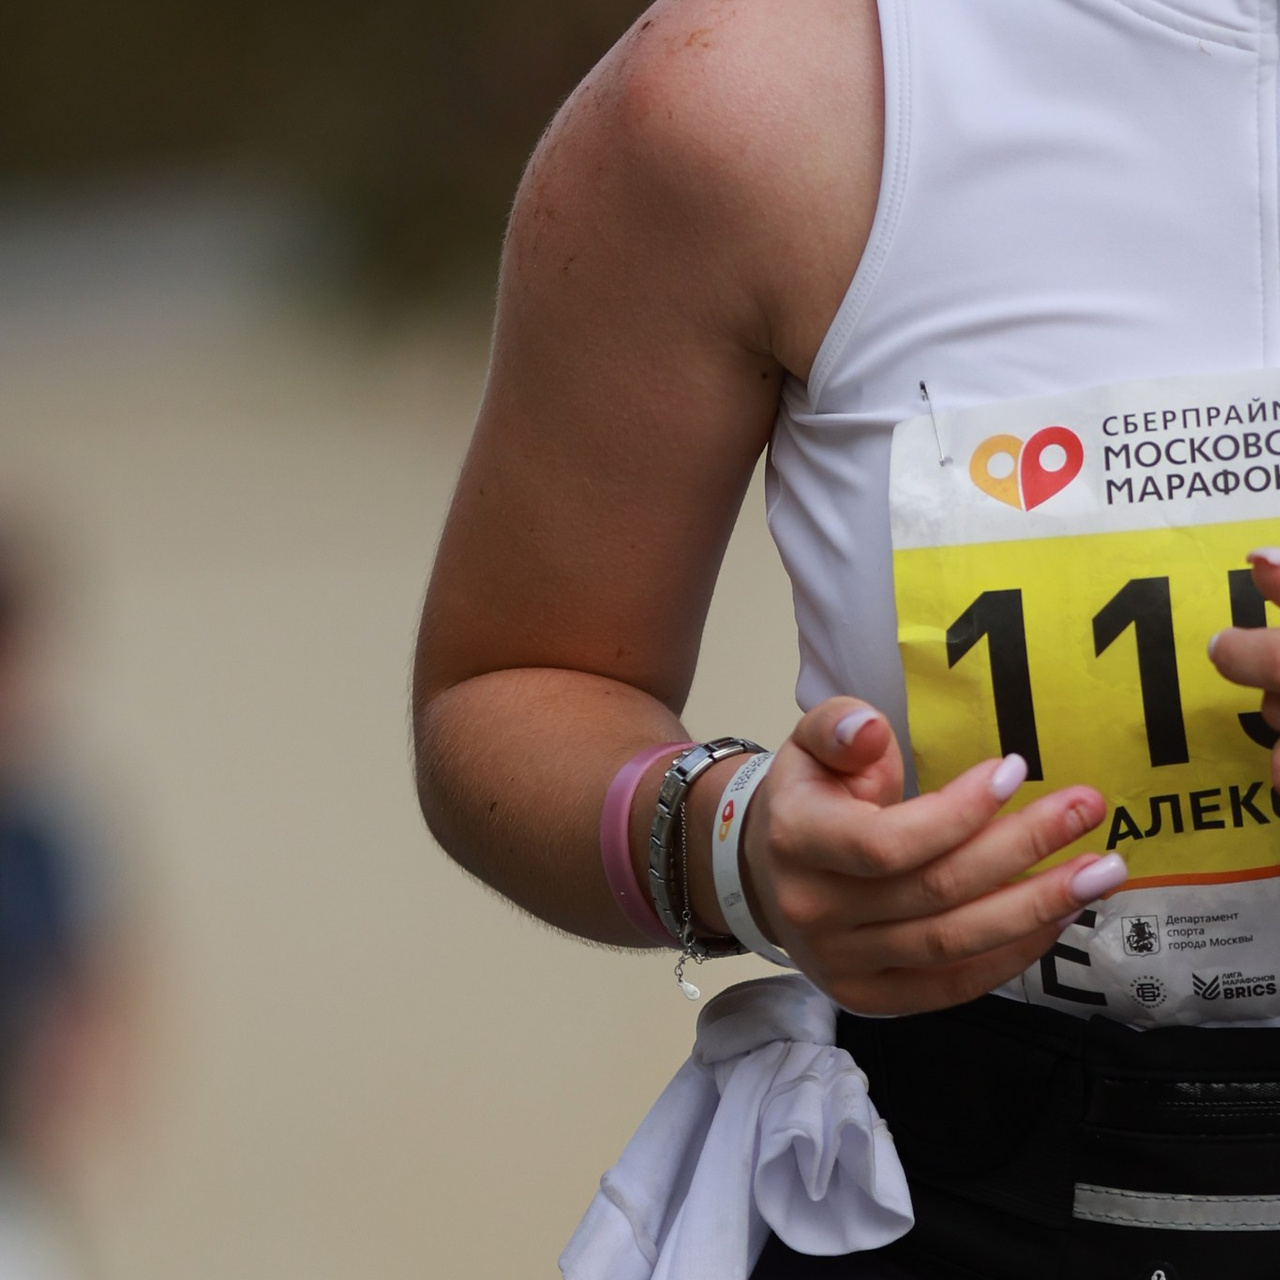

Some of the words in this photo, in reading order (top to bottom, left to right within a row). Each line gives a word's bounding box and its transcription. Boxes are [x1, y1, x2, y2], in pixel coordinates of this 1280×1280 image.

[1165, 912, 1239, 926] Департамент
[1166, 927, 1205, 938] спорта
[1168, 940, 1207, 951] города
[1209, 934, 1254, 947] Москвы
[1222, 974, 1276, 986] МАРАФОНОВ
[1223, 982, 1277, 1000] BRICS
